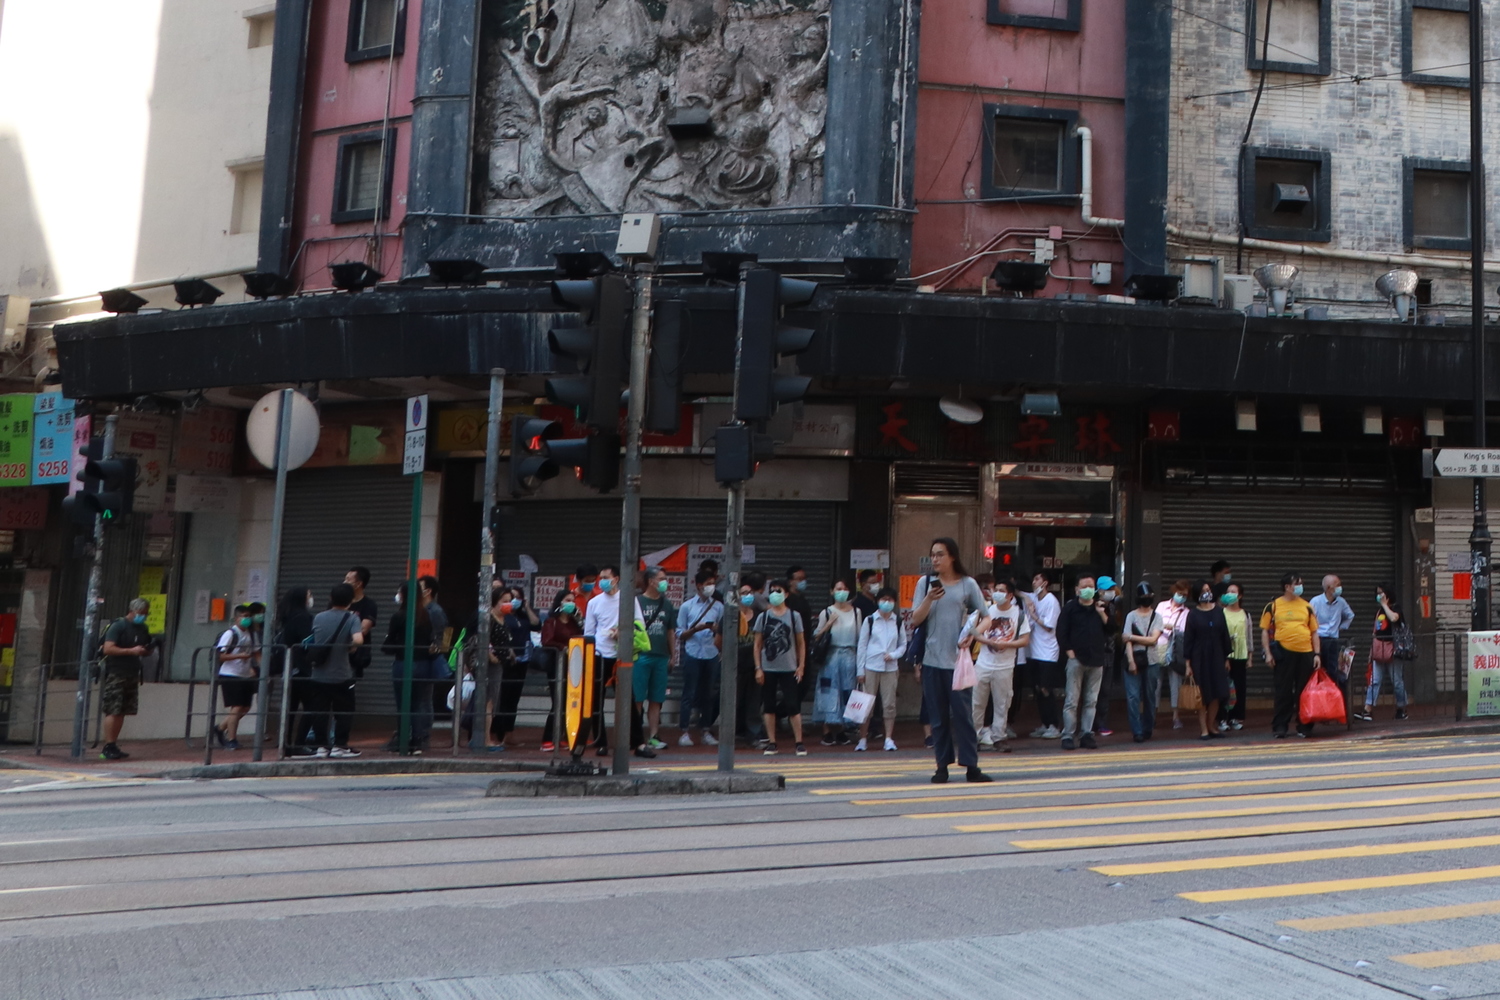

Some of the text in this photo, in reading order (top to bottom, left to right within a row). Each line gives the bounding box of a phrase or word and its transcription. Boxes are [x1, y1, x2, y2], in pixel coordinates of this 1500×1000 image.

[1463, 452, 1485, 461] King's
[38, 460, 69, 478] $258
[1469, 464, 1500, 474] 英皇道
